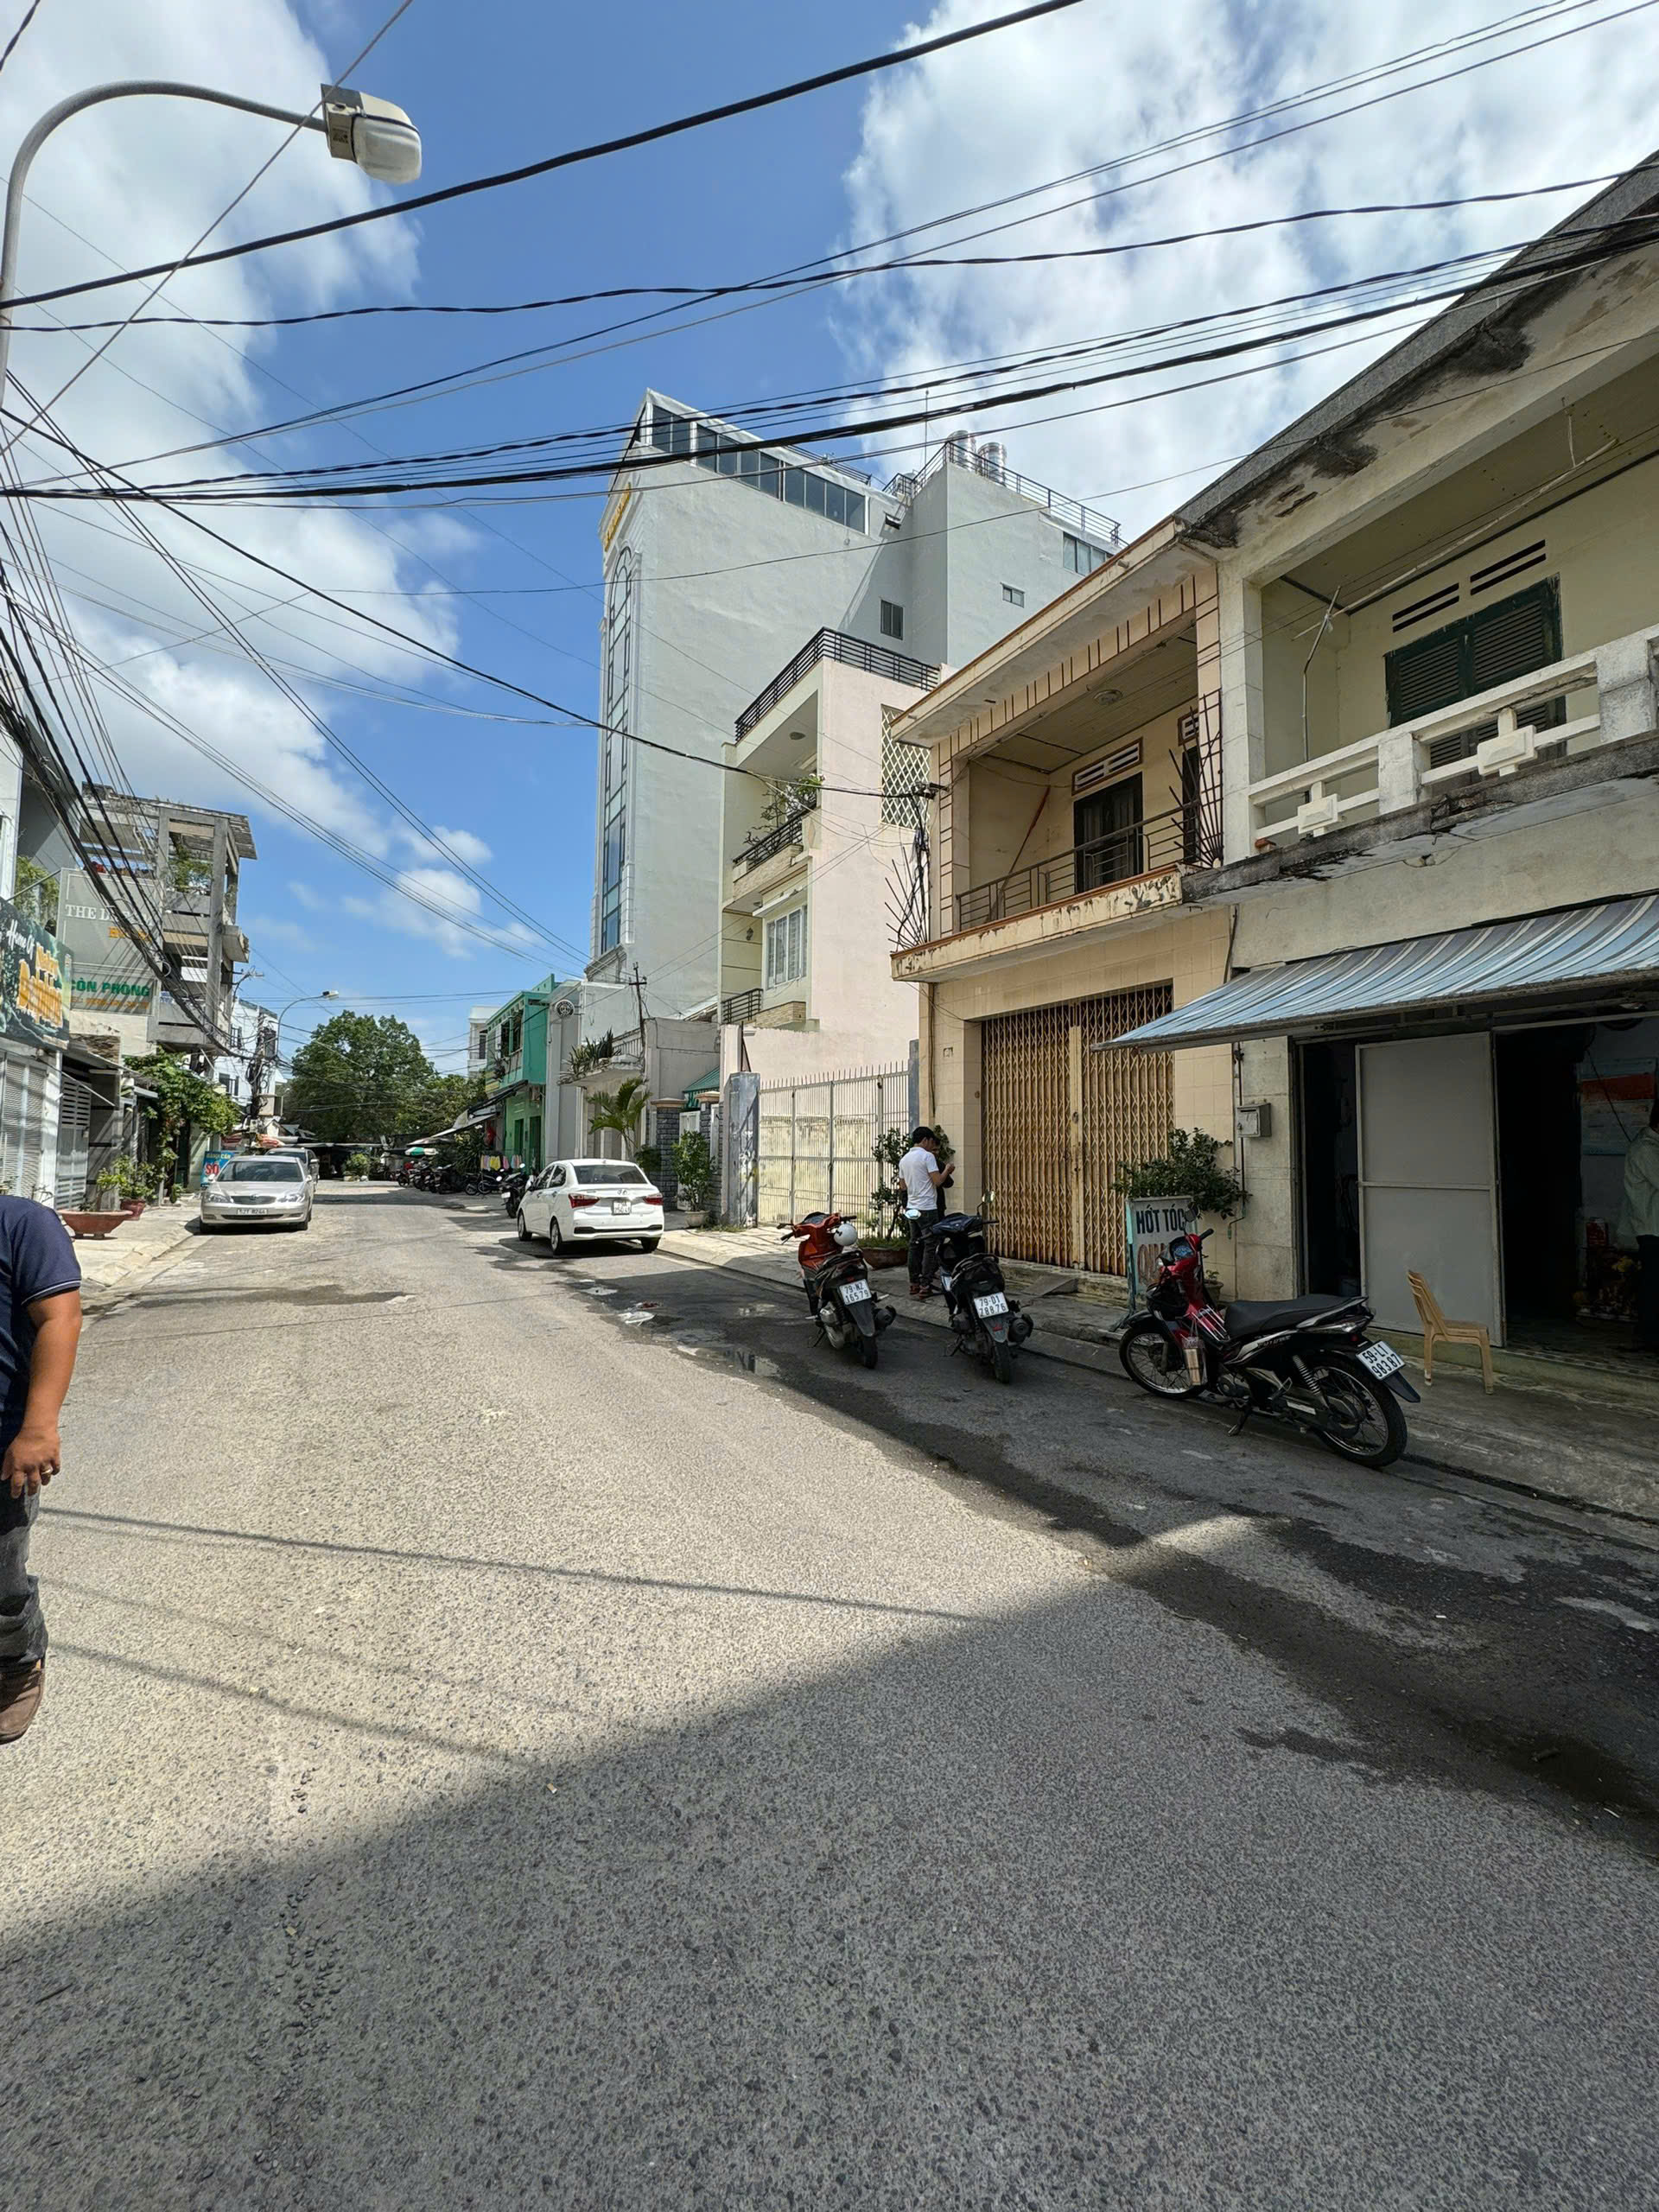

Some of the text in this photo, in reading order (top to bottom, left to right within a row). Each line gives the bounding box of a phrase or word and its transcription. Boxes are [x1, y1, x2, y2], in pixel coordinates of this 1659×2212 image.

[65, 904, 96, 919] THE
[1135, 1203, 1185, 1235] HỚT TÓC
[1361, 1344, 1389, 1363] 59-L1
